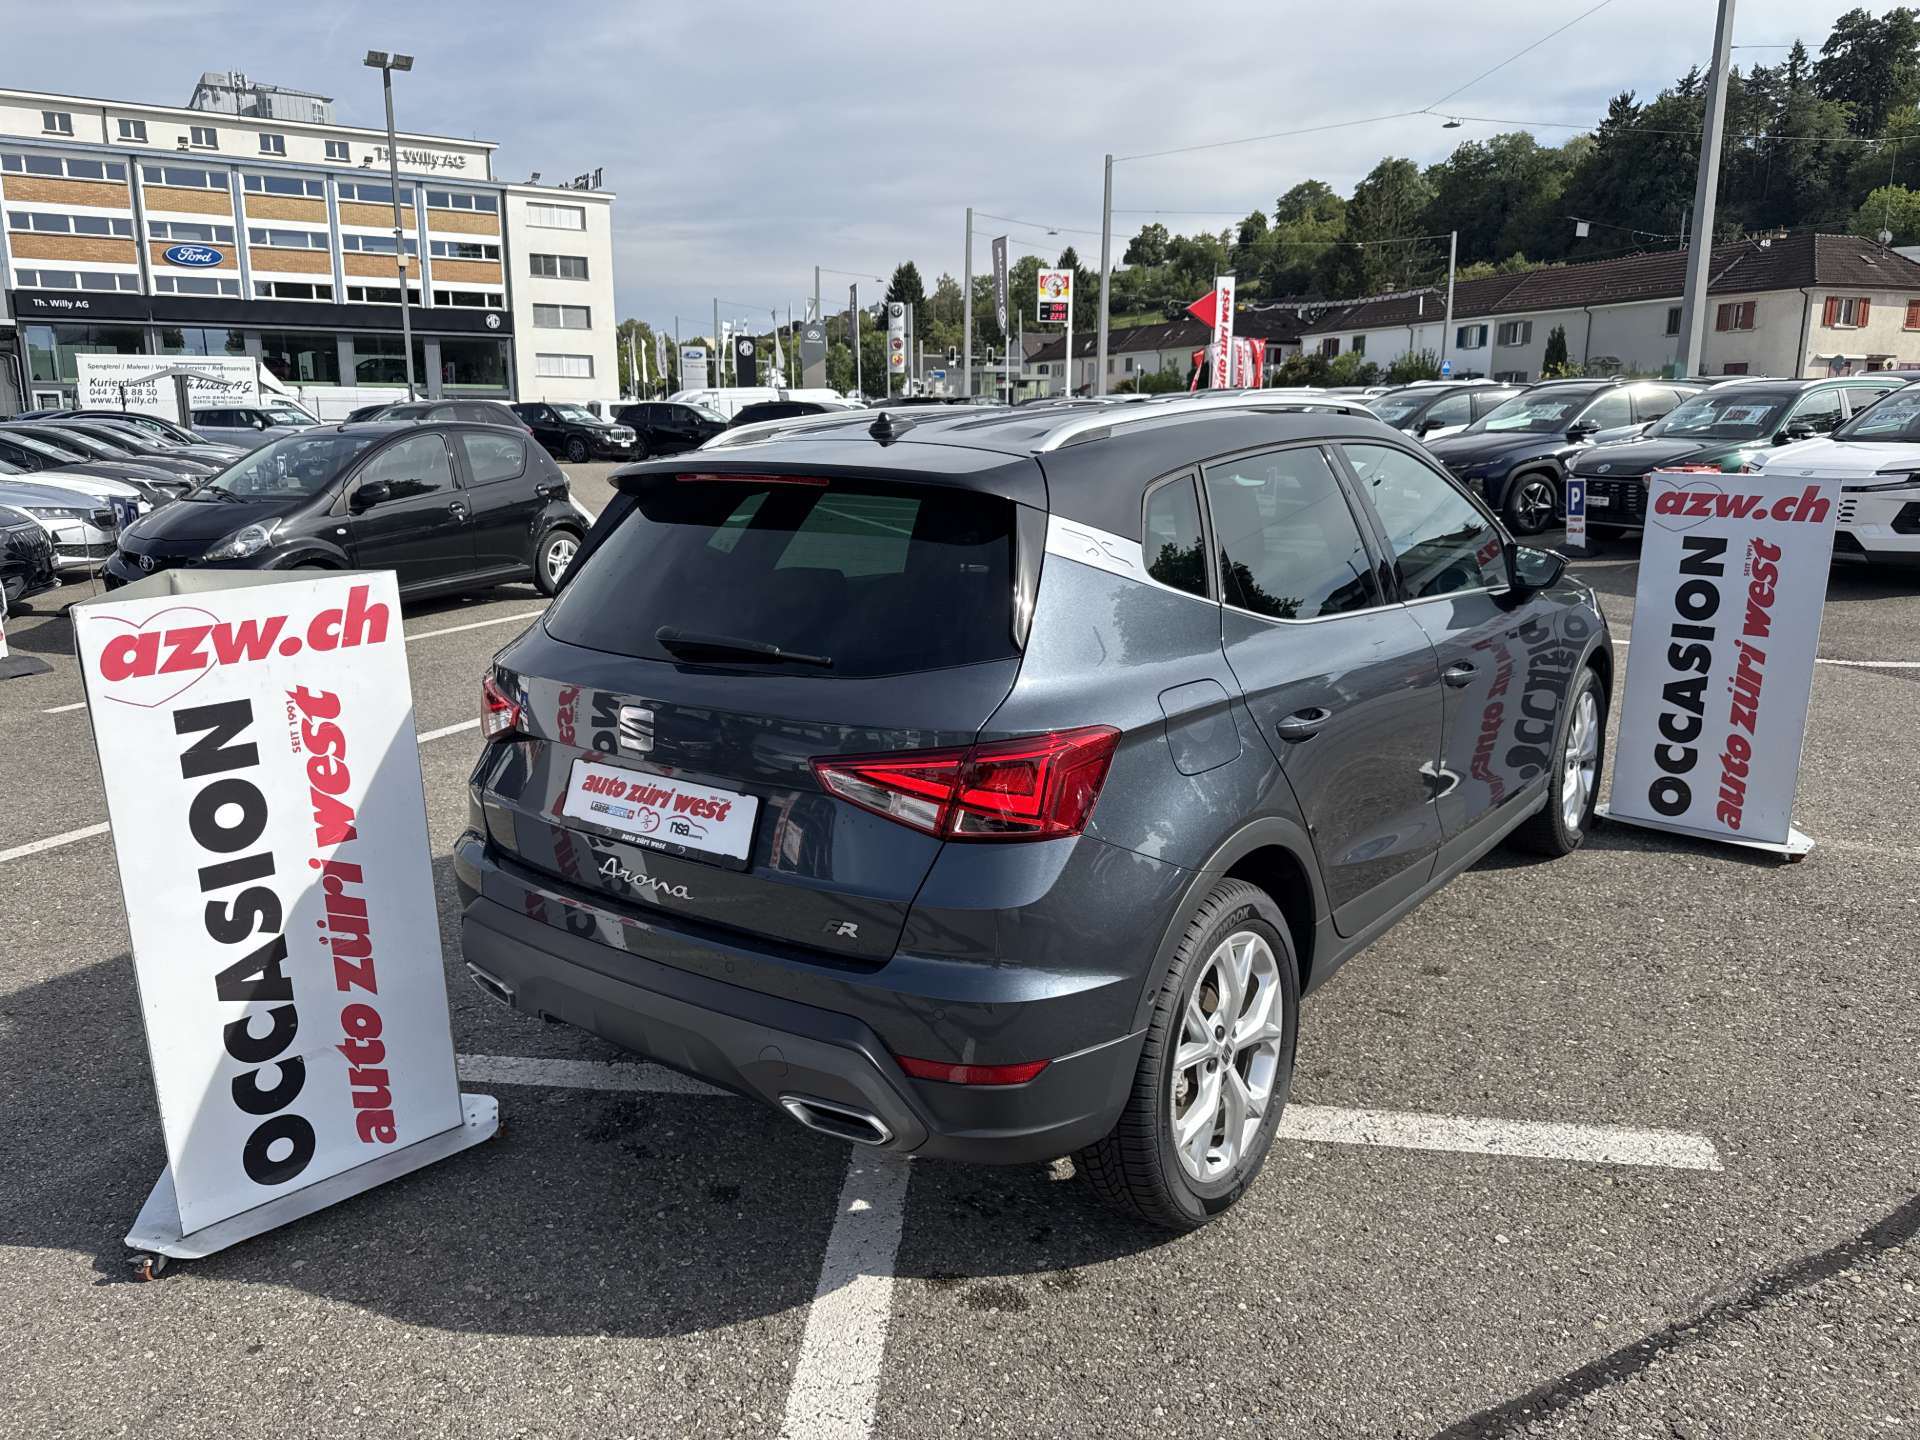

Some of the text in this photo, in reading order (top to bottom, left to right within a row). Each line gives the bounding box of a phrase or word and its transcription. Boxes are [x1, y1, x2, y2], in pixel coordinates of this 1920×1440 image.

[402, 149, 439, 170] Willy
[1760, 239, 1771, 248] 48
[177, 247, 213, 262] Ford
[32, 298, 90, 310] Th. Willy AG
[486, 314, 500, 328] MG
[739, 341, 754, 356] MG
[89, 388, 107, 396] 044
[131, 388, 143, 396] 88
[146, 388, 158, 396] 50
[231, 380, 254, 394] AG
[1571, 487, 1581, 511] P
[1654, 485, 1831, 524] azw.ch
[114, 503, 125, 522] P
[1745, 544, 1753, 561] 1991
[100, 586, 389, 682] azw.ch
[1648, 535, 1729, 817] OCCASION
[1716, 537, 1782, 831] auto züri west
[286, 700, 301, 753] SEIT 1991
[582, 774, 732, 822] auto züri west
[669, 821, 690, 836] nsa
[621, 833, 636, 842] auto
[650, 840, 667, 850] west
[598, 857, 695, 900] Arona
[285, 684, 397, 1144] auto züri west
[173, 698, 316, 1186] OCCASION
